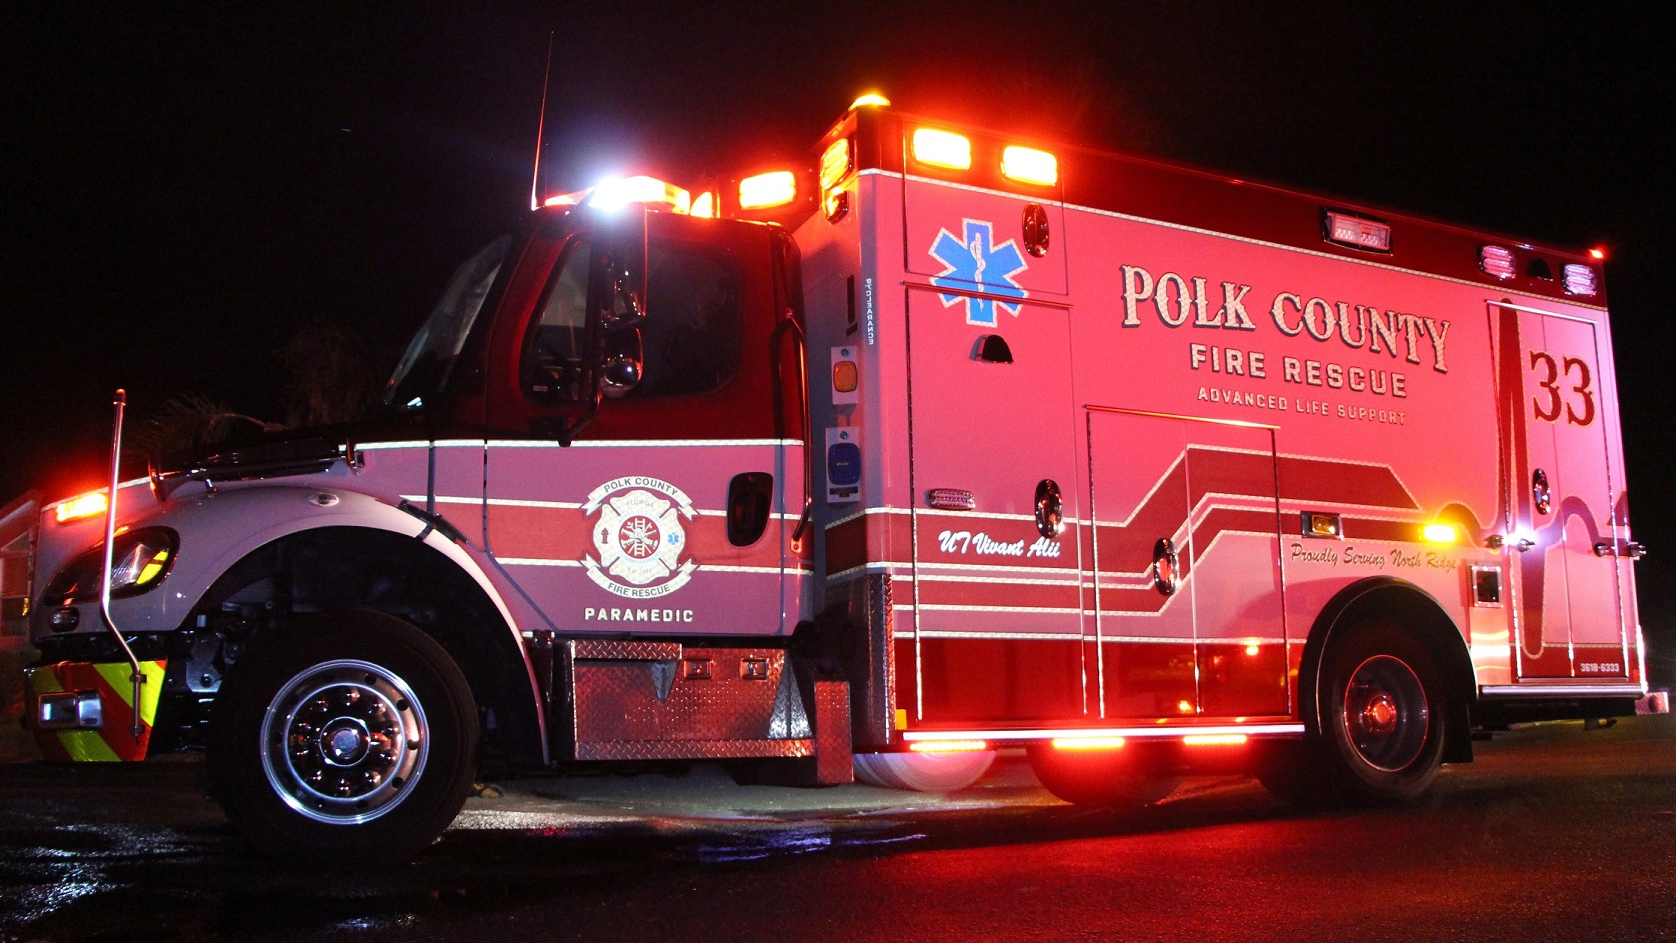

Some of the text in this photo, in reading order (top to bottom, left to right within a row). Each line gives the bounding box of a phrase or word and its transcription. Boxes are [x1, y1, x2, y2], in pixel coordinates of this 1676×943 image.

[1120, 264, 1451, 374] POLK COUNTY
[1190, 343, 1407, 398] FIRE RESCUE
[1528, 349, 1595, 427] 33
[1197, 386, 1406, 426] ADVANCED LIFE SUPPORT
[603, 477, 678, 496] POLK COUNTY
[626, 499, 654, 508] FLORIDA
[972, 532, 1025, 556] Vivant
[1026, 536, 1060, 557] Alii
[1290, 542, 1457, 573] Proudly Serving North Ridge
[607, 581, 671, 598] FIRE RESCUE
[584, 607, 694, 622] PARAMEDIC
